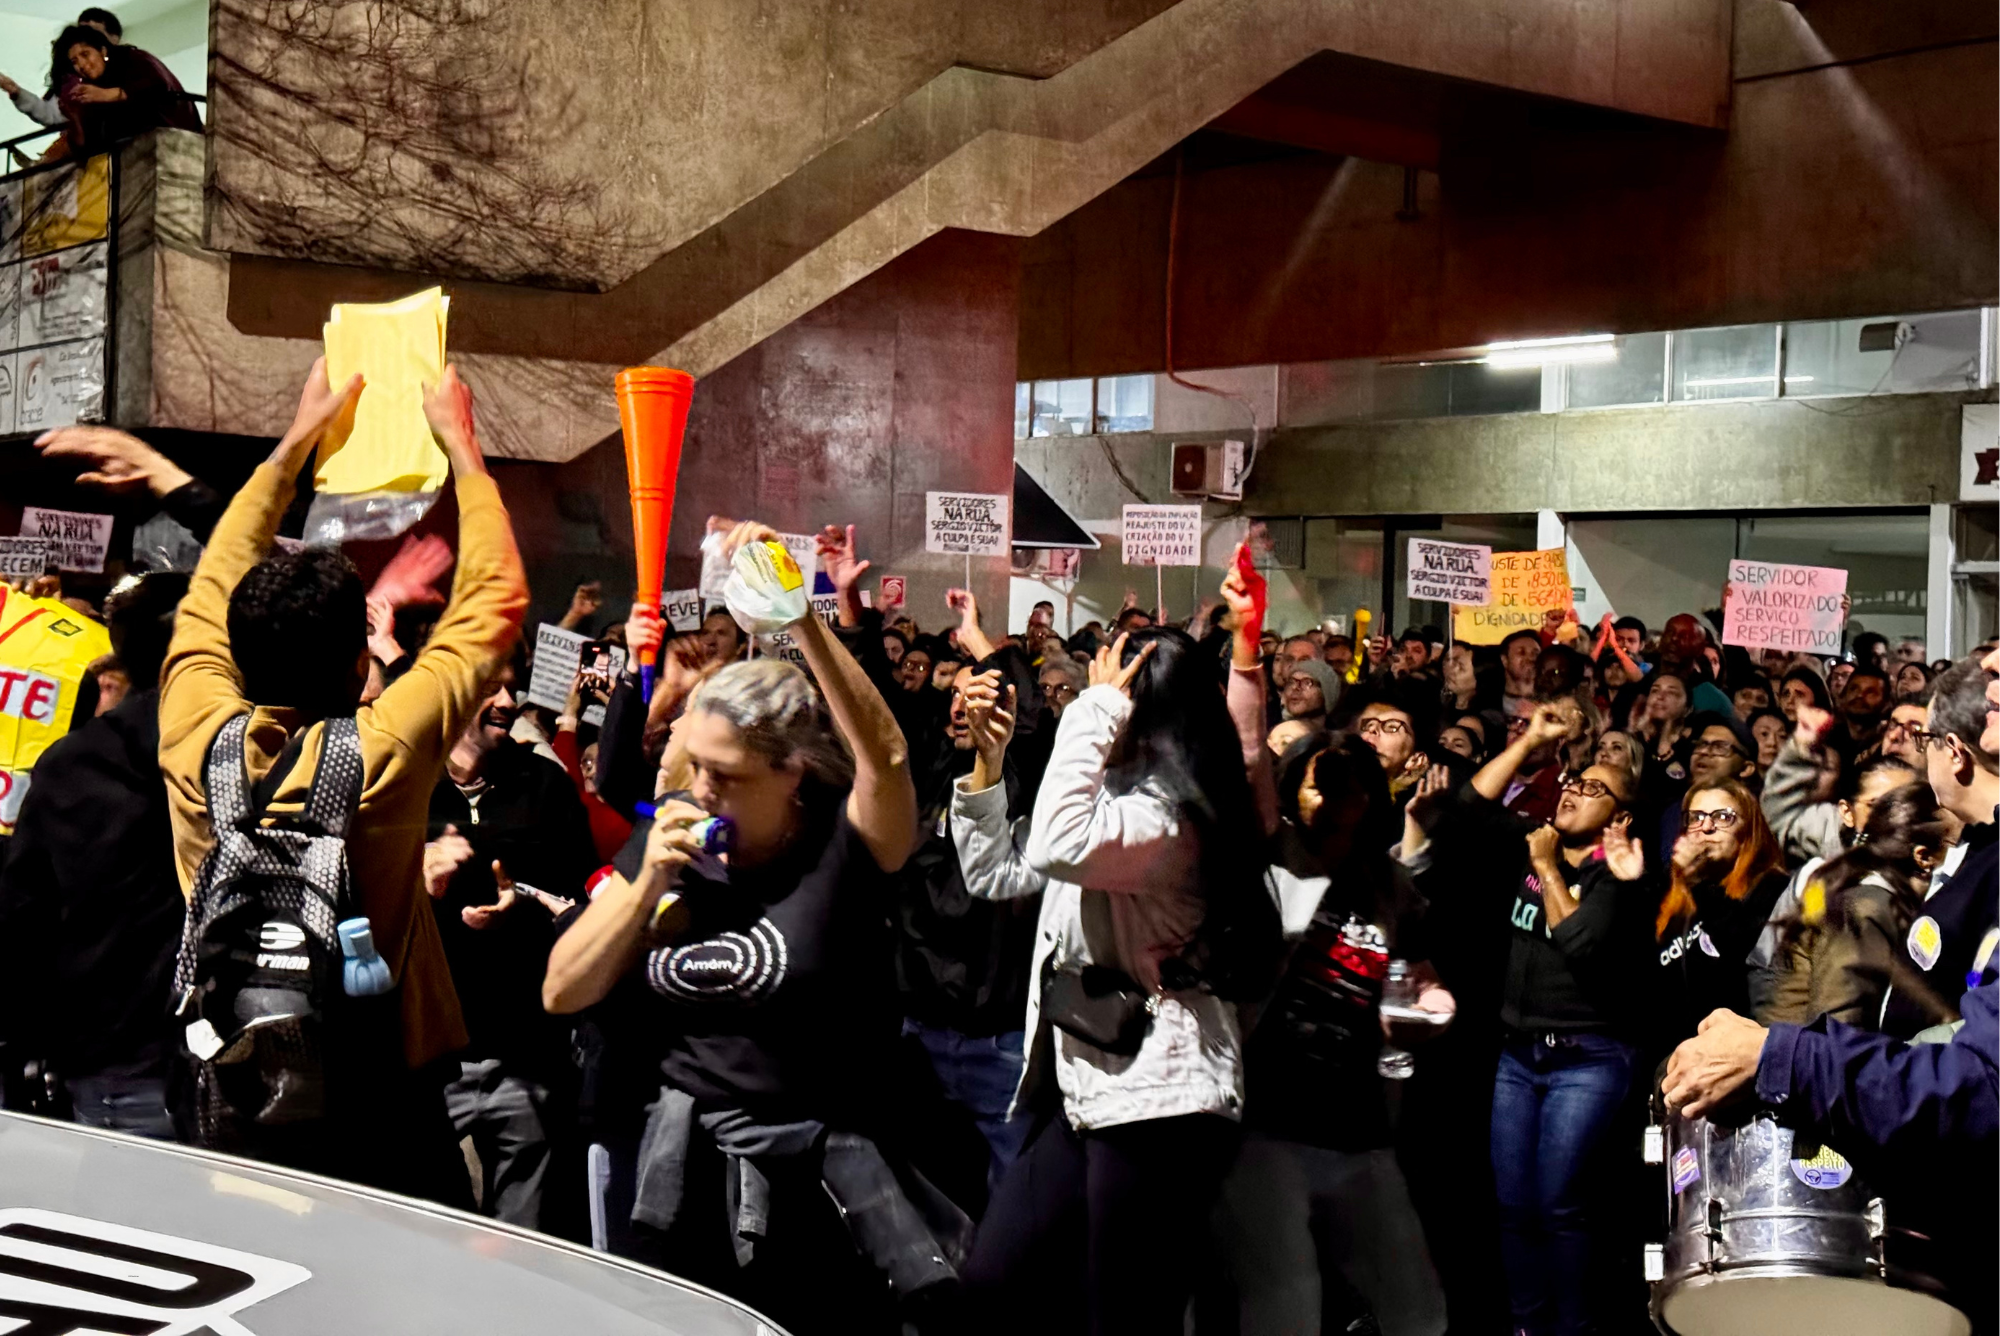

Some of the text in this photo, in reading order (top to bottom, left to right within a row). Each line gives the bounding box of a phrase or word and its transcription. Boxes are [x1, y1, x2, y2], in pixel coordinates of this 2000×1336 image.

[944, 507, 963, 520] NA
[1126, 521, 1165, 530] REAJUSTE
[1127, 545, 1194, 556] DIGNIDADE
[1417, 542, 1481, 560] SERVIDORES
[1424, 555, 1444, 570] NA
[1451, 573, 1488, 588] VICTOR
[1502, 576, 1521, 589] DE
[1735, 565, 1819, 587] SERVIDOR
[1414, 585, 1421, 594] A
[1422, 586, 1451, 599] CULPA
[1502, 592, 1519, 607] DE
[1742, 589, 1838, 613] VALORIZADO
[1734, 607, 1799, 627] SERVIÇO
[1736, 623, 1841, 647] RESPEITADO!
